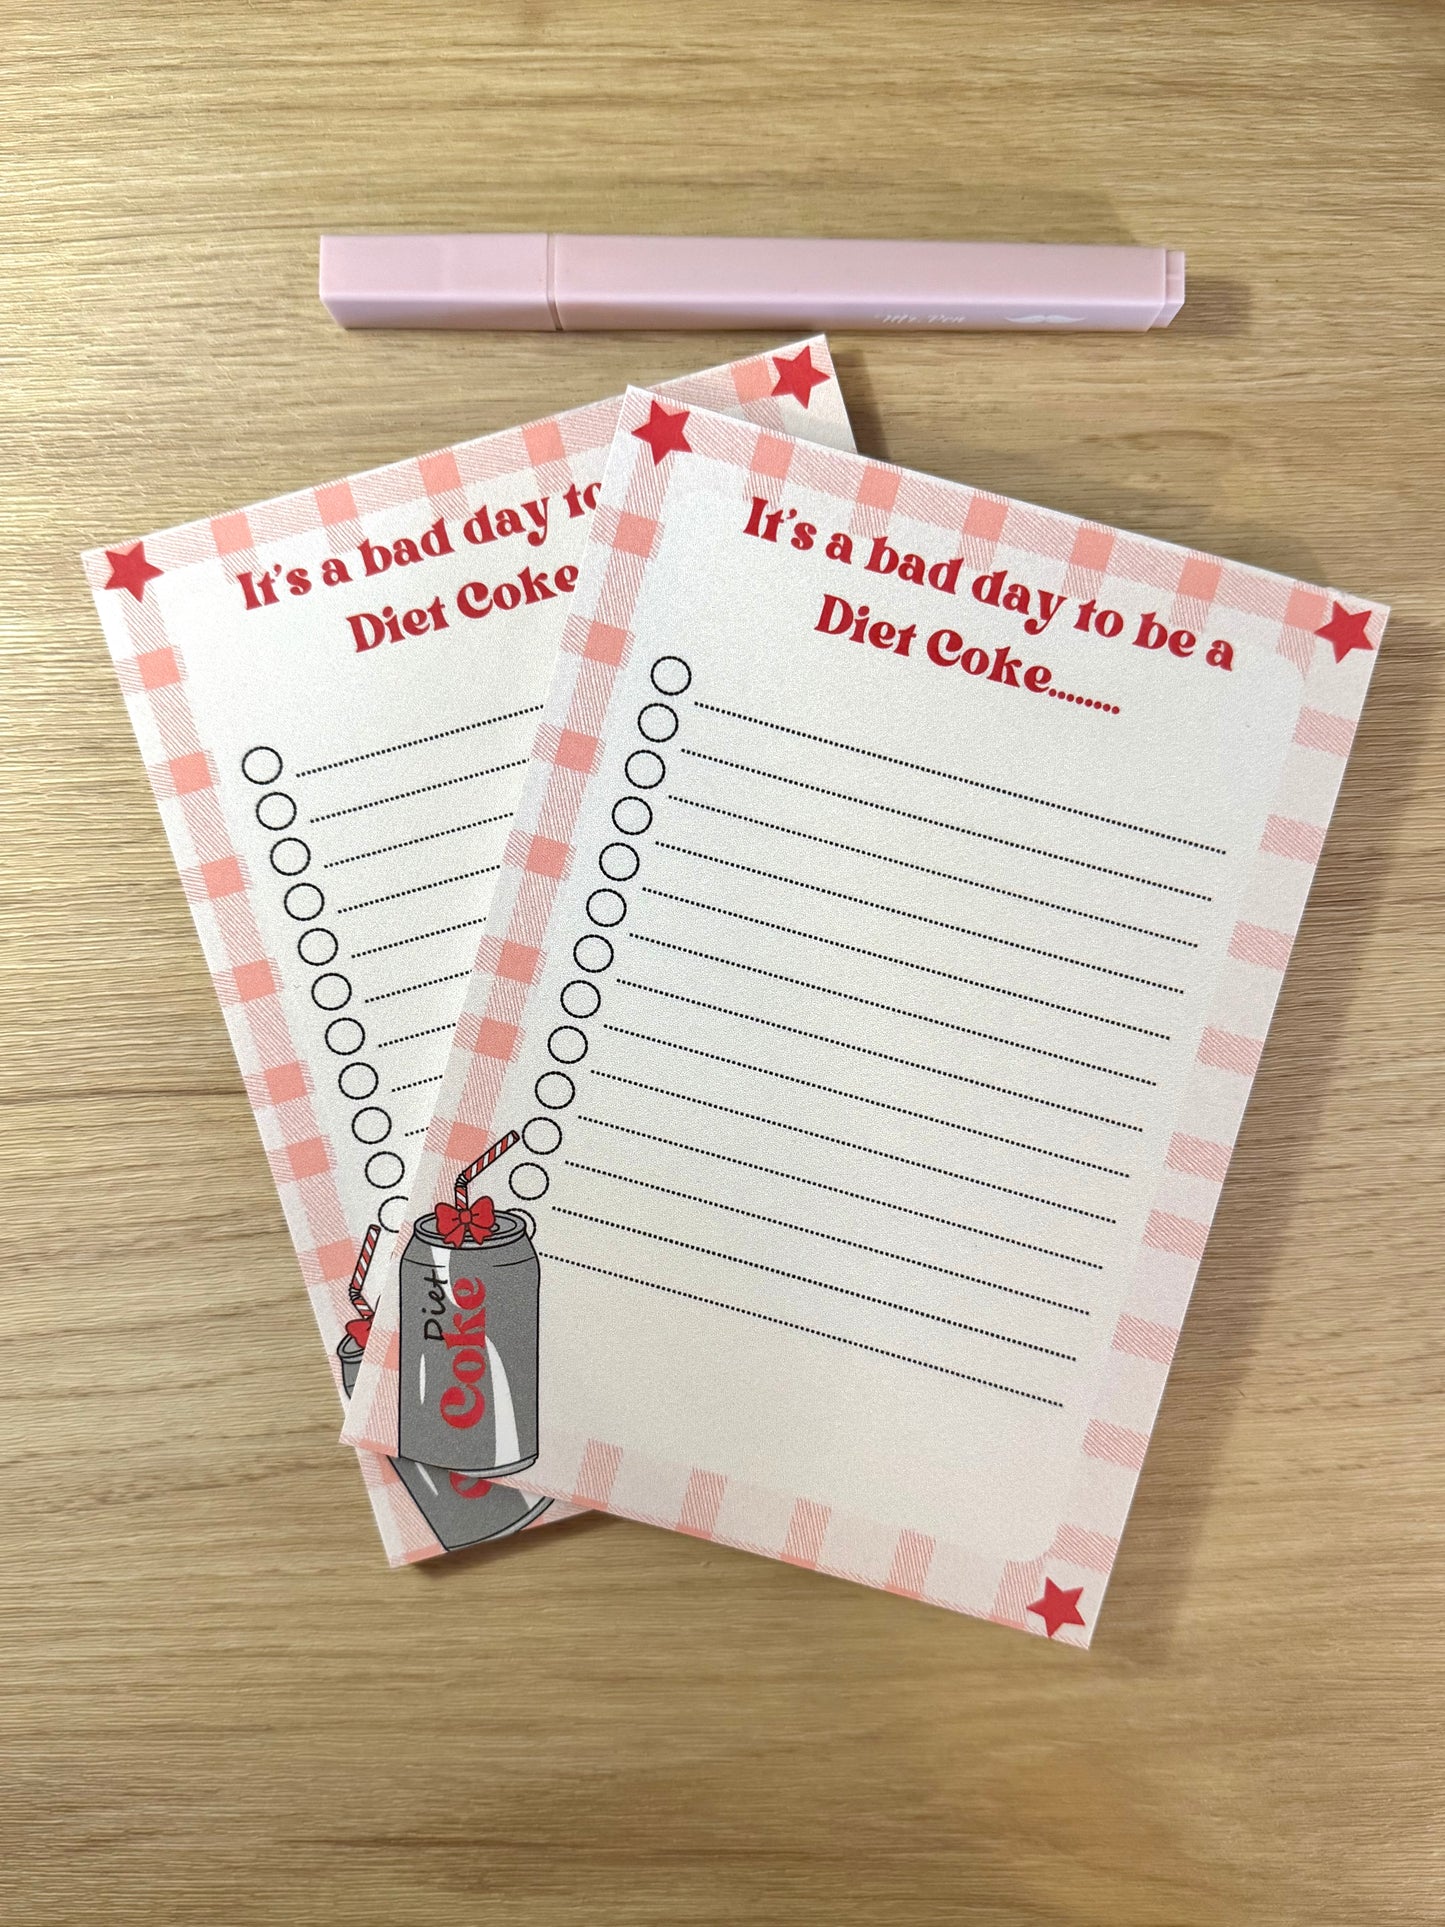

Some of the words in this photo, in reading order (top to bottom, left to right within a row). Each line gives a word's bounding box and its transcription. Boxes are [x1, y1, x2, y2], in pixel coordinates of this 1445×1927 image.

[236, 563, 312, 610] It's
[321, 558, 353, 587] a
[358, 517, 455, 577] bad
[463, 497, 550, 547] day
[743, 496, 817, 550] It's
[825, 533, 853, 564] a
[864, 536, 964, 594] bad
[971, 570, 1067, 635] day
[1074, 599, 1124, 638] to
[1132, 612, 1196, 658] be
[1206, 640, 1235, 671] a
[346, 596, 450, 653] Diet
[456, 565, 579, 619] Coke
[814, 594, 917, 657] Diet
[423, 1268, 449, 1342] Diet
[440, 1277, 487, 1430] Coke
